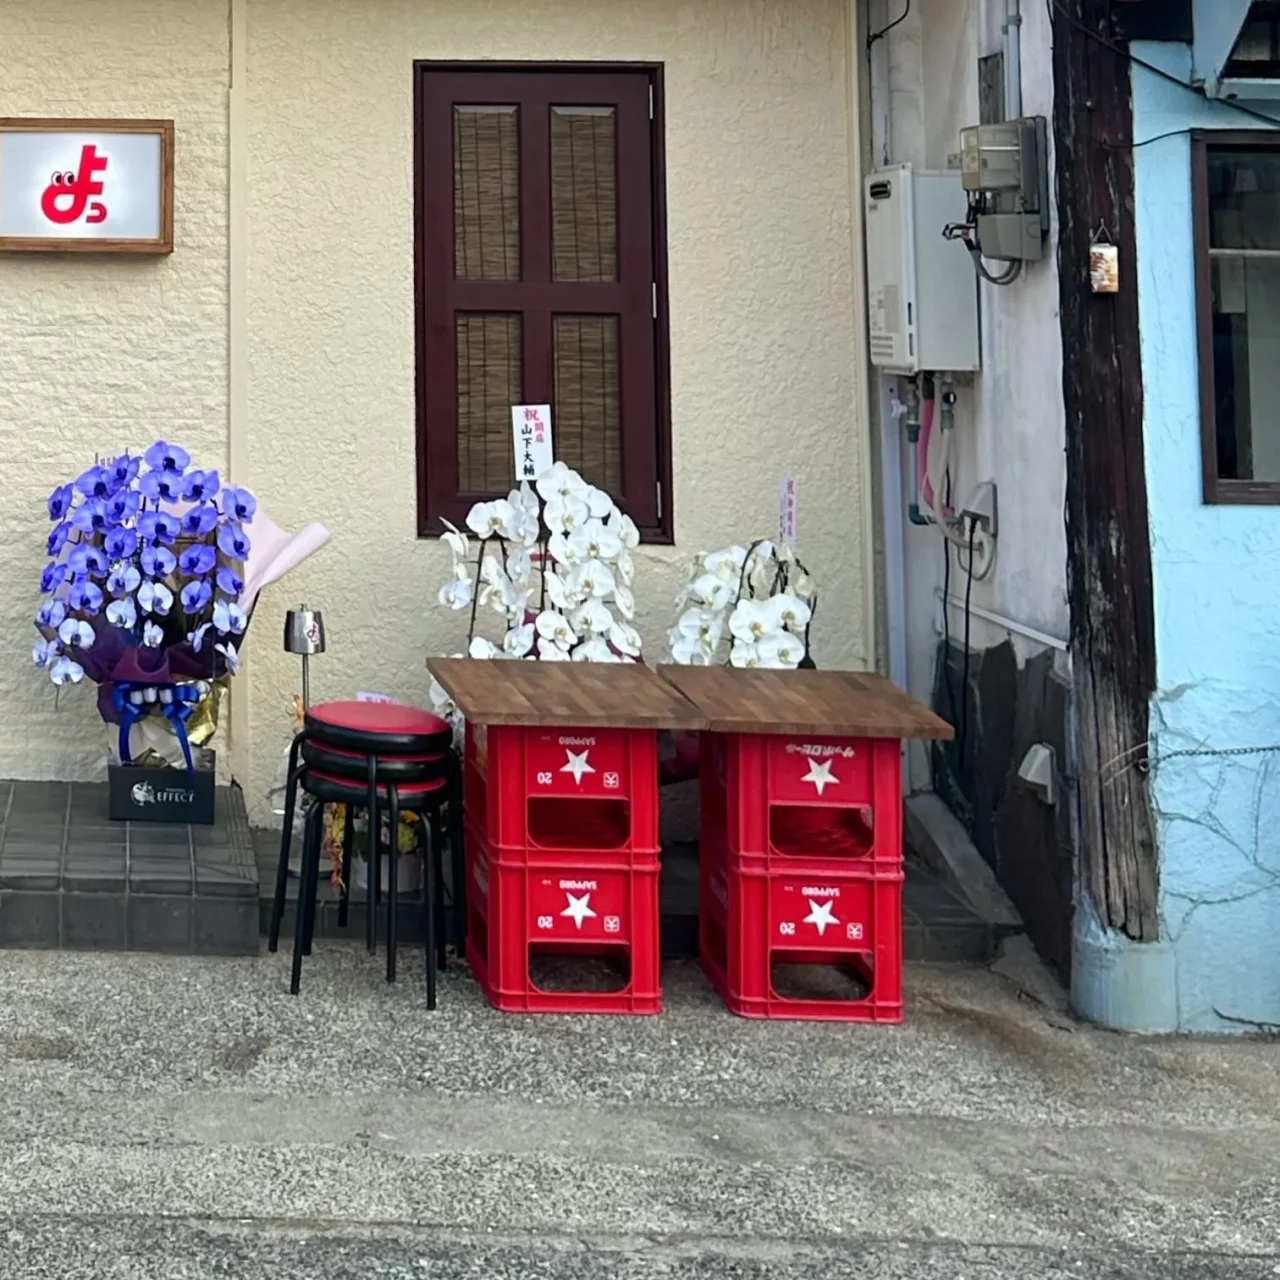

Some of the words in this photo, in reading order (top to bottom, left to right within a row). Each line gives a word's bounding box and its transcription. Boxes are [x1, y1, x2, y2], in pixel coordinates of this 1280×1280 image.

[558, 736, 596, 745] SAPPORO
[536, 771, 553, 785] 20
[157, 791, 194, 802] EFFECT
[559, 880, 597, 890] SAPPORO
[801, 886, 840, 897] SAPPORO
[537, 915, 554, 929] 20
[779, 922, 796, 935] 20
